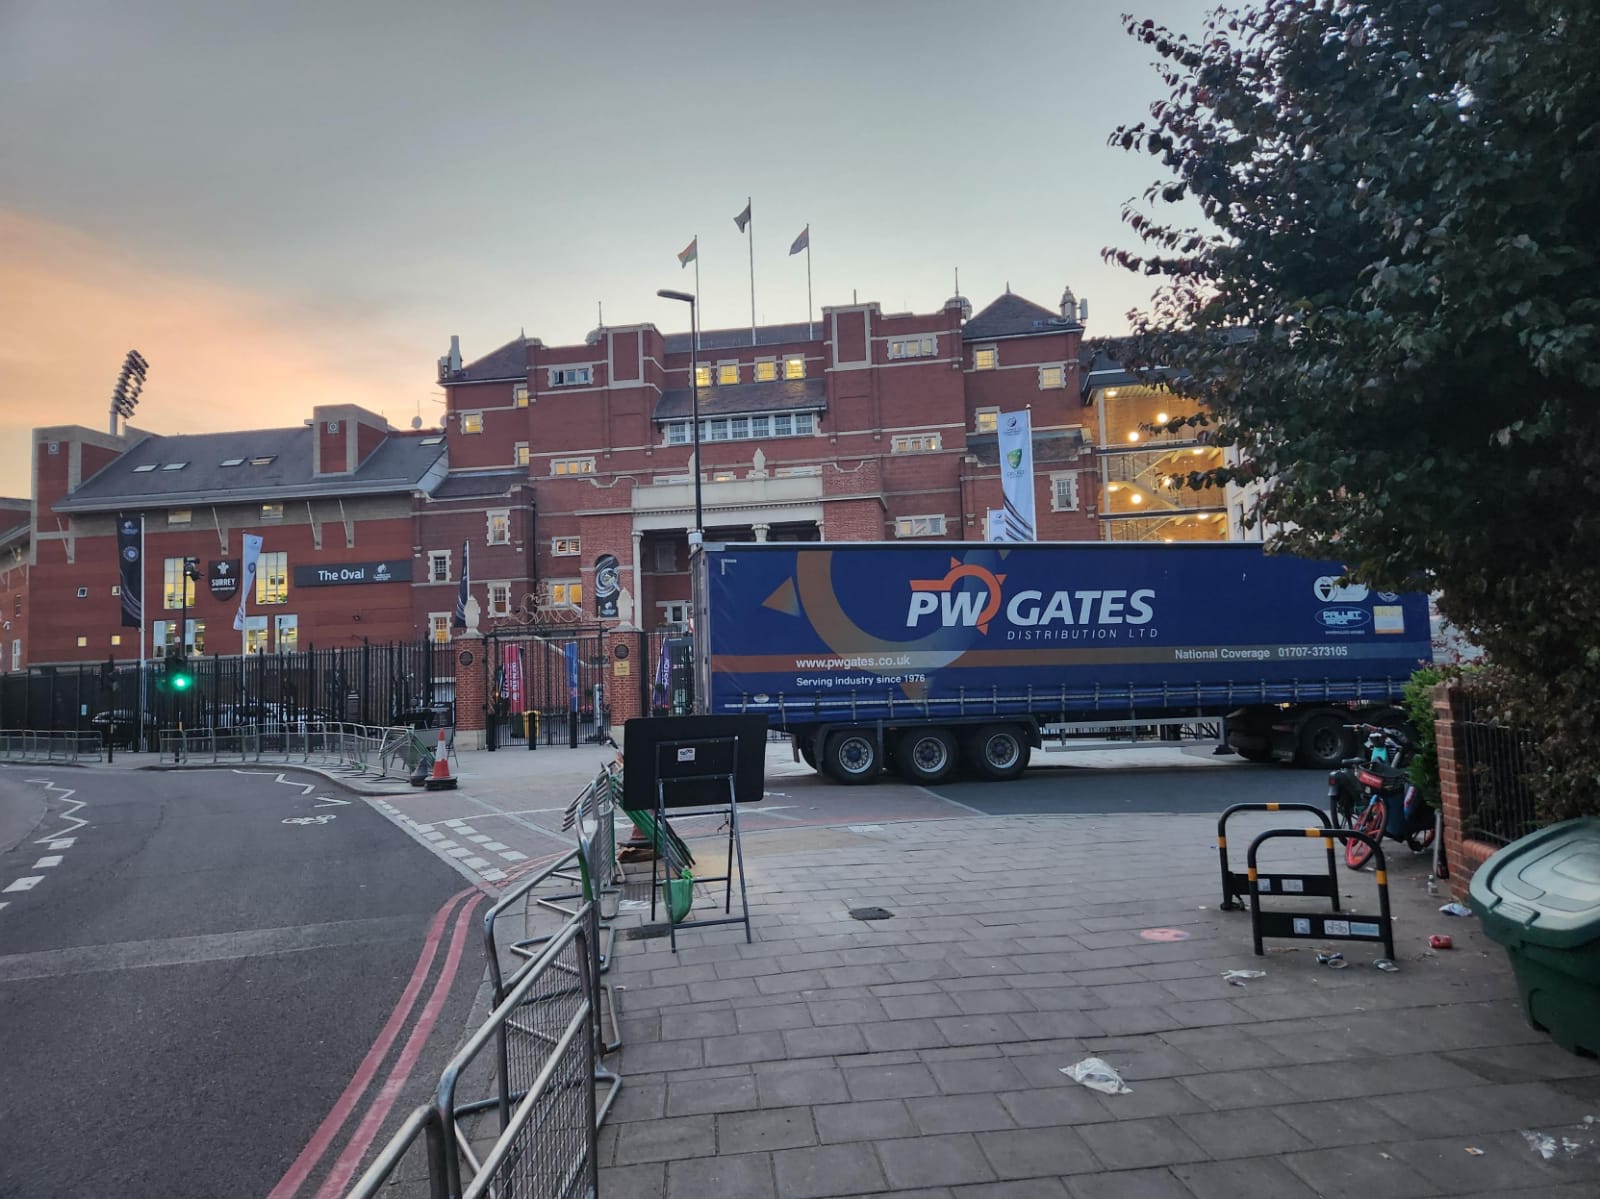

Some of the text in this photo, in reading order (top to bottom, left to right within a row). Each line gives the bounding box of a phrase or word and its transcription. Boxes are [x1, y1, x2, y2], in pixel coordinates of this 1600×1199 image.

[318, 570, 338, 581] The
[340, 568, 364, 580] Oval
[211, 578, 235, 586] SURREY
[906, 589, 1156, 627] PW GATES
[1007, 627, 1158, 641] DISTRIBUTION LTD
[1174, 646, 1348, 661] National Coverage 01707-373105
[795, 654, 911, 670] www.pwgates.co.uk
[796, 674, 926, 688] Serving industry since 1976
